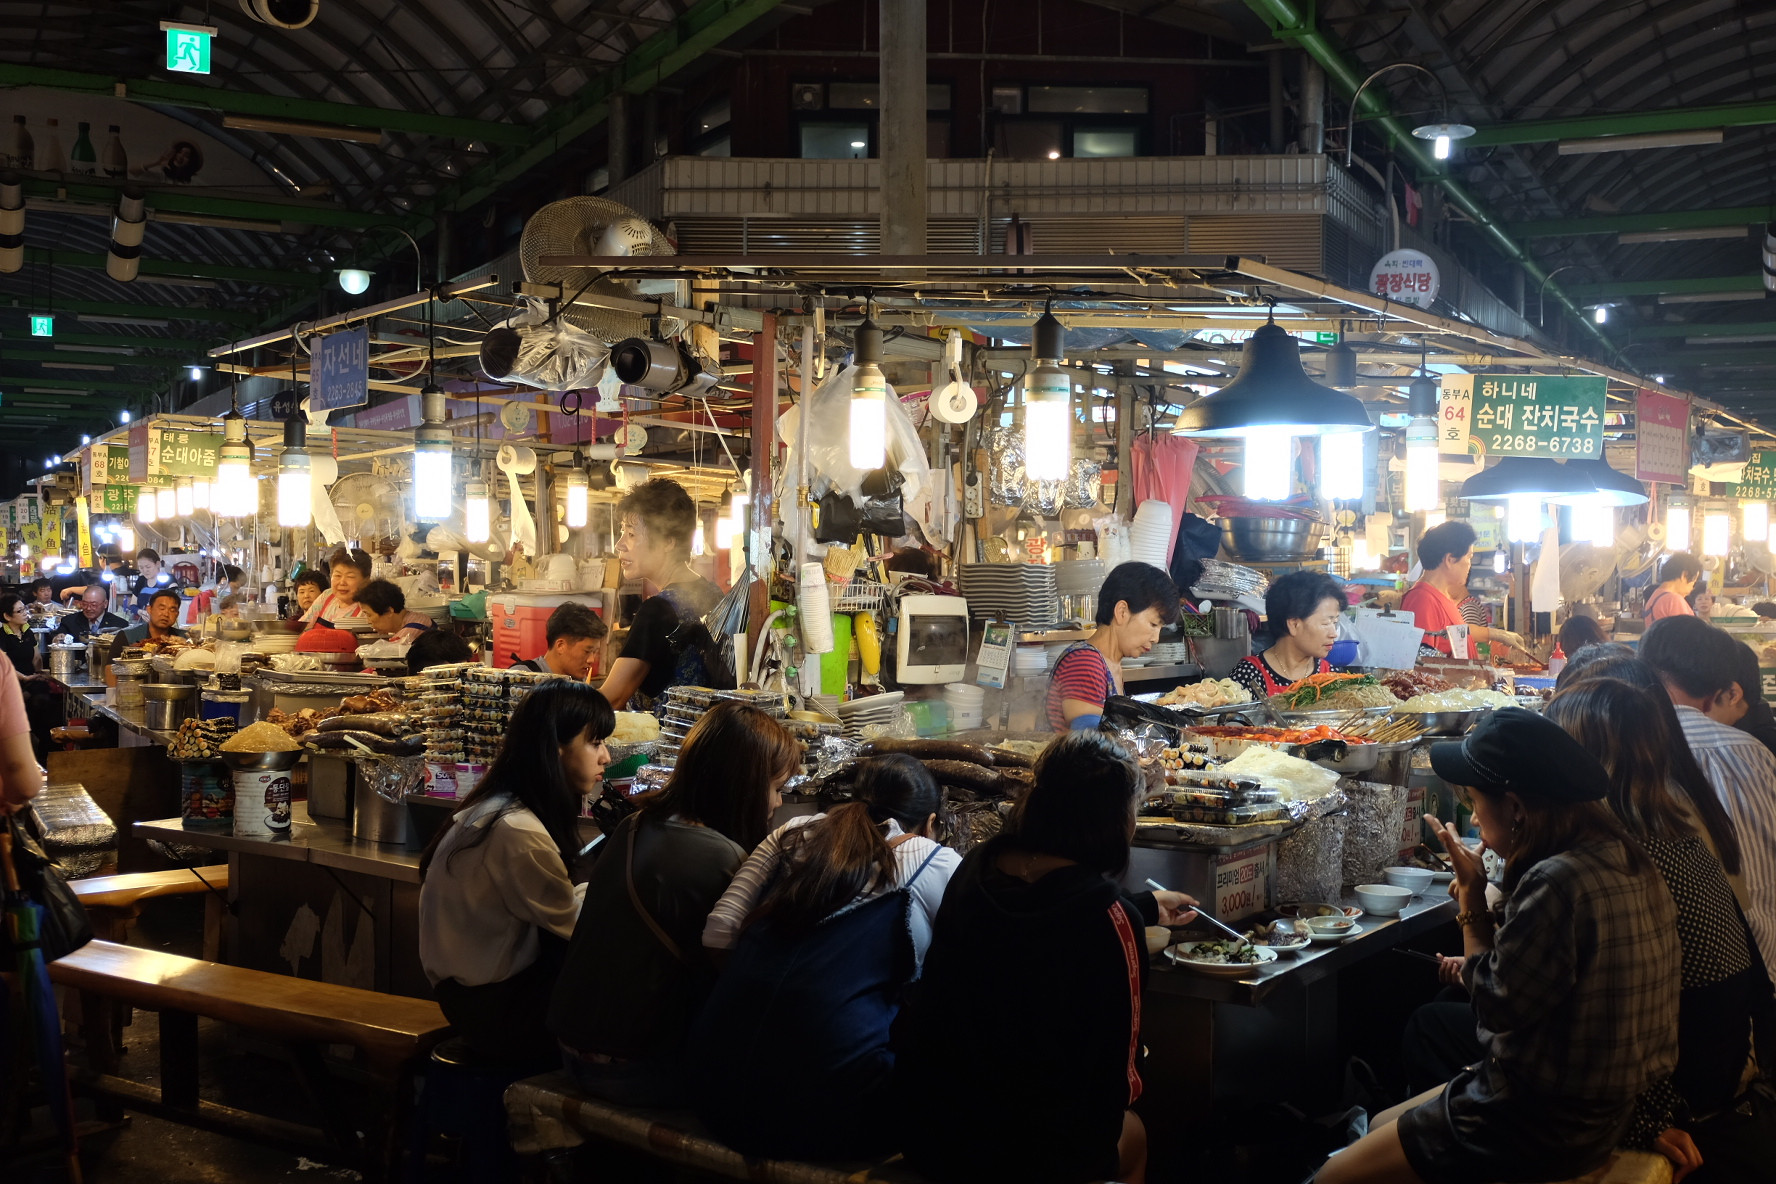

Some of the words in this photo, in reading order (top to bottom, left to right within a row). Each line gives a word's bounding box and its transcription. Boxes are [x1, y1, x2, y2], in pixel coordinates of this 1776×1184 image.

[1375, 272, 1432, 293] 광장식당
[323, 338, 364, 376] 자선네
[1442, 388, 1470, 401] 동부A
[1482, 381, 1537, 401] 하니네
[1444, 405, 1466, 422] 64
[1476, 402, 1514, 431] 순대
[1521, 404, 1600, 434] 잔치국수
[1445, 427, 1461, 441] 호
[1491, 434, 1595, 454] 2268-6738
[94, 460, 105, 469] 68
[161, 445, 216, 467] 순대아줌
[1216, 867, 1240, 889] 프리미엄
[1127, 941, 1139, 978] Supreme
